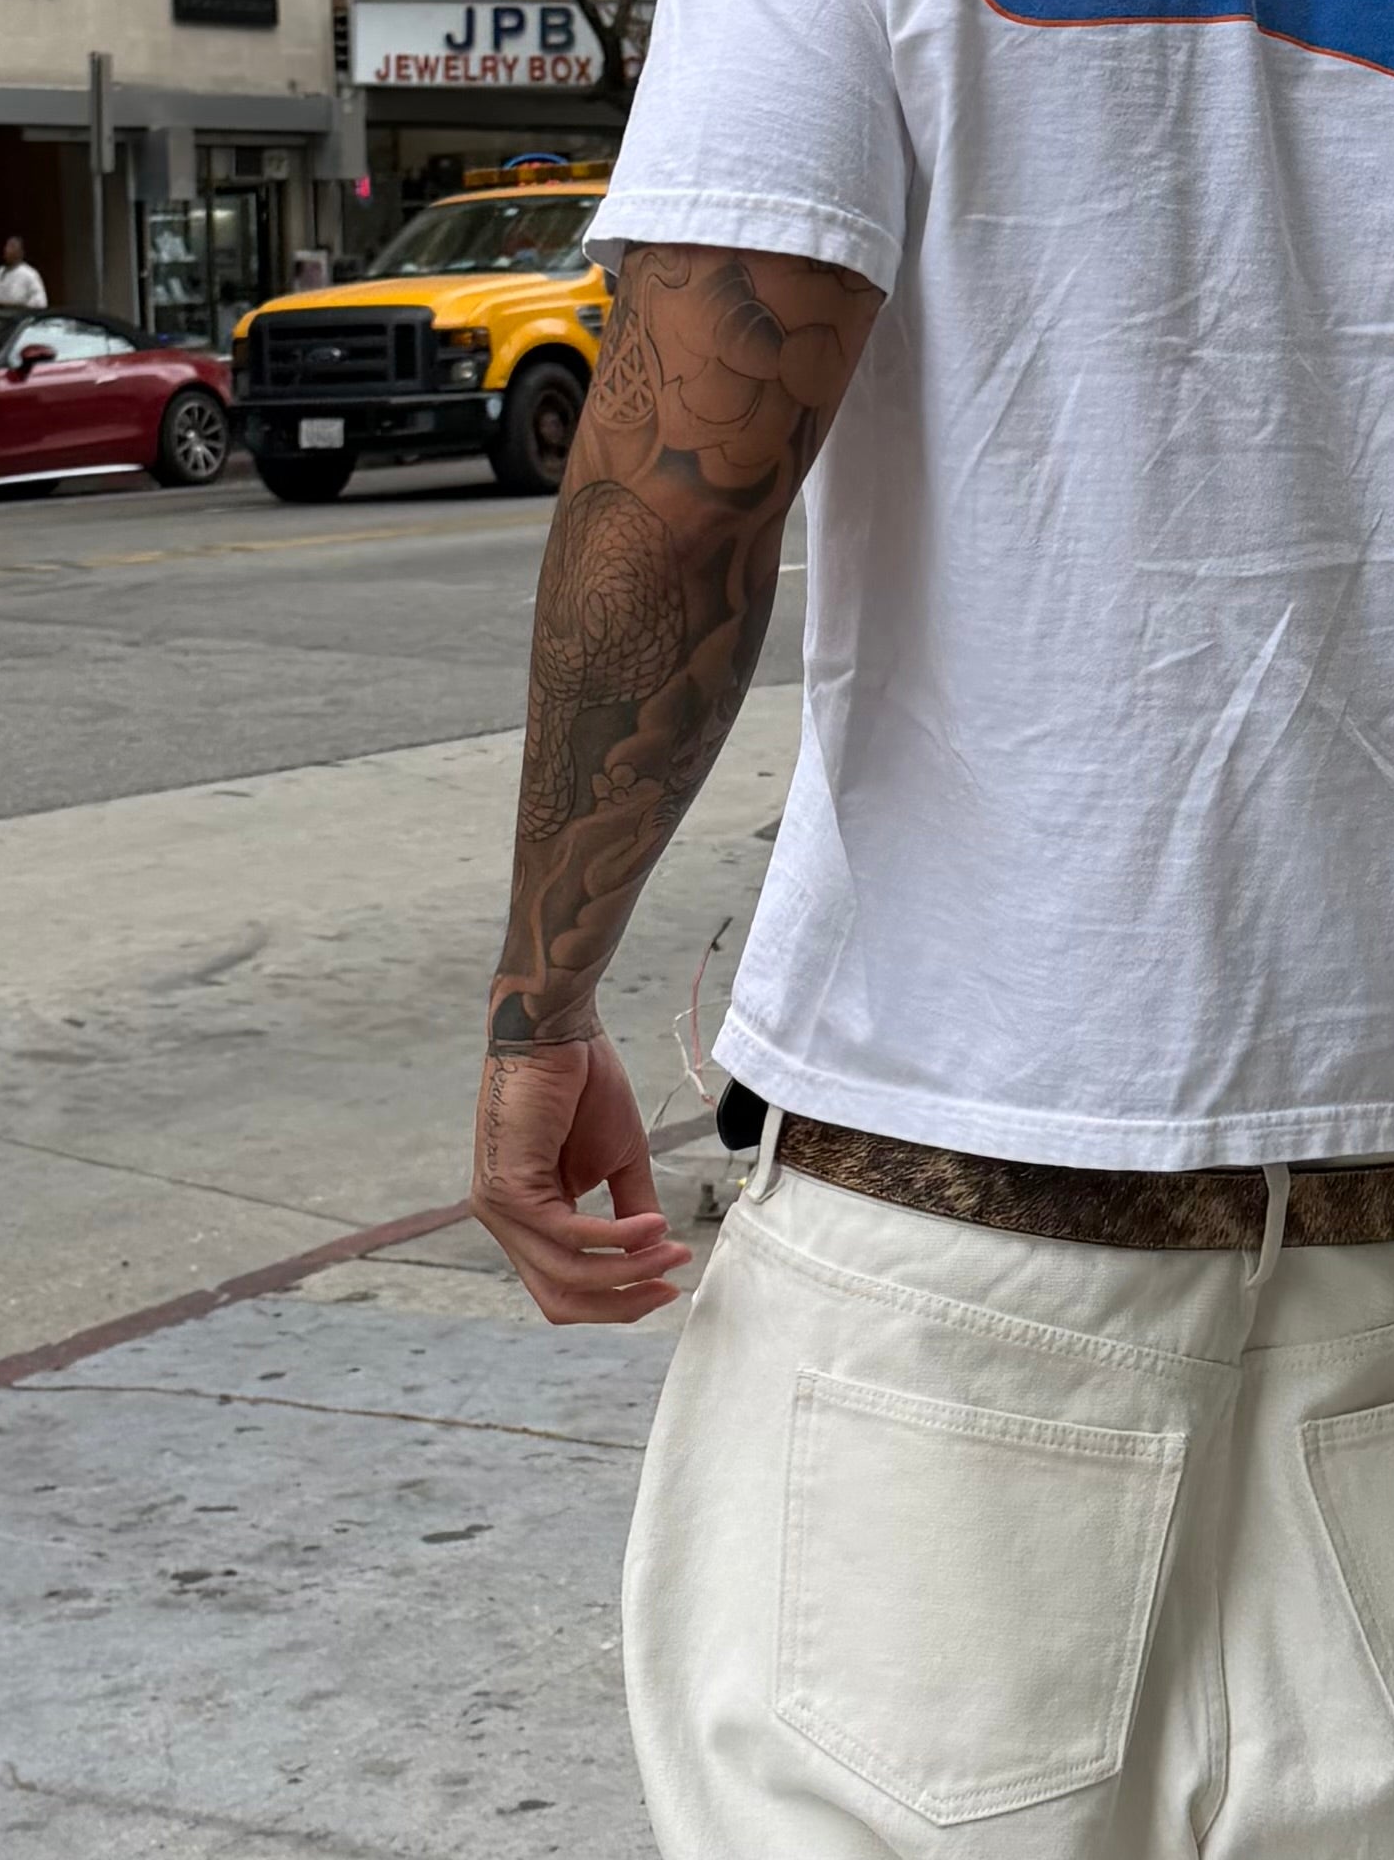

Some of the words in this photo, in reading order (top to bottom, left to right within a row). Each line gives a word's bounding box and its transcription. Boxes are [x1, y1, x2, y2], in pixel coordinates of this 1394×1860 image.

[444, 5, 576, 53] JPB
[375, 53, 520, 83] JEWELRY
[528, 55, 594, 84] BOX
